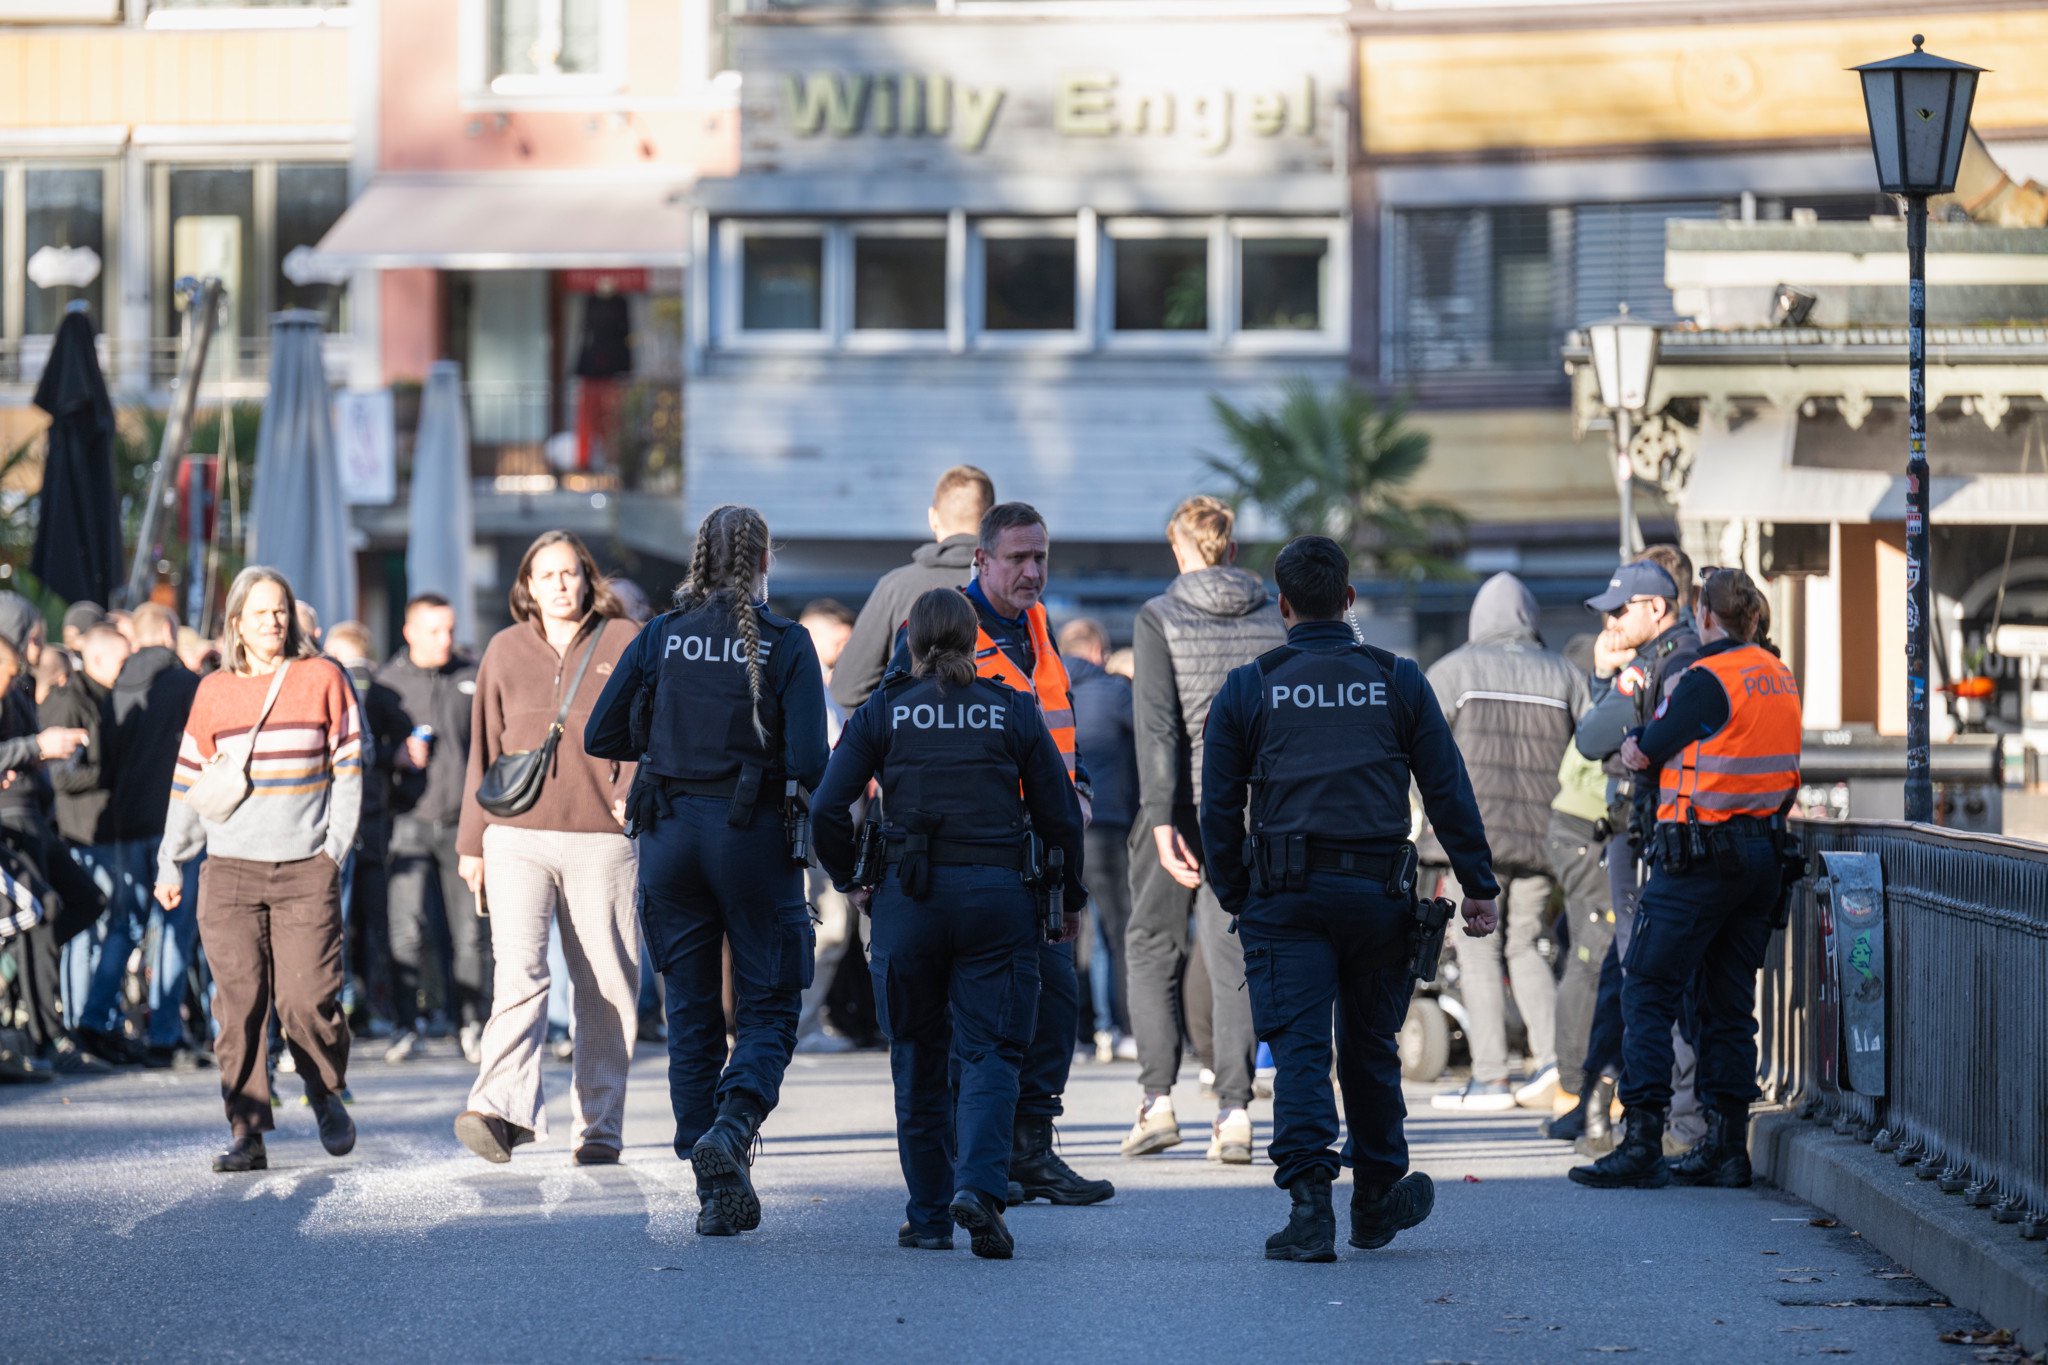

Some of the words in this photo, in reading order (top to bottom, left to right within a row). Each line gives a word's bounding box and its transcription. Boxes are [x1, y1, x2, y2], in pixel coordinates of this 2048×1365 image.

[784, 71, 1006, 152] Willy
[1056, 72, 1317, 154] Engel
[1272, 682, 1387, 709] POLICE
[892, 703, 1006, 730] POLICE
